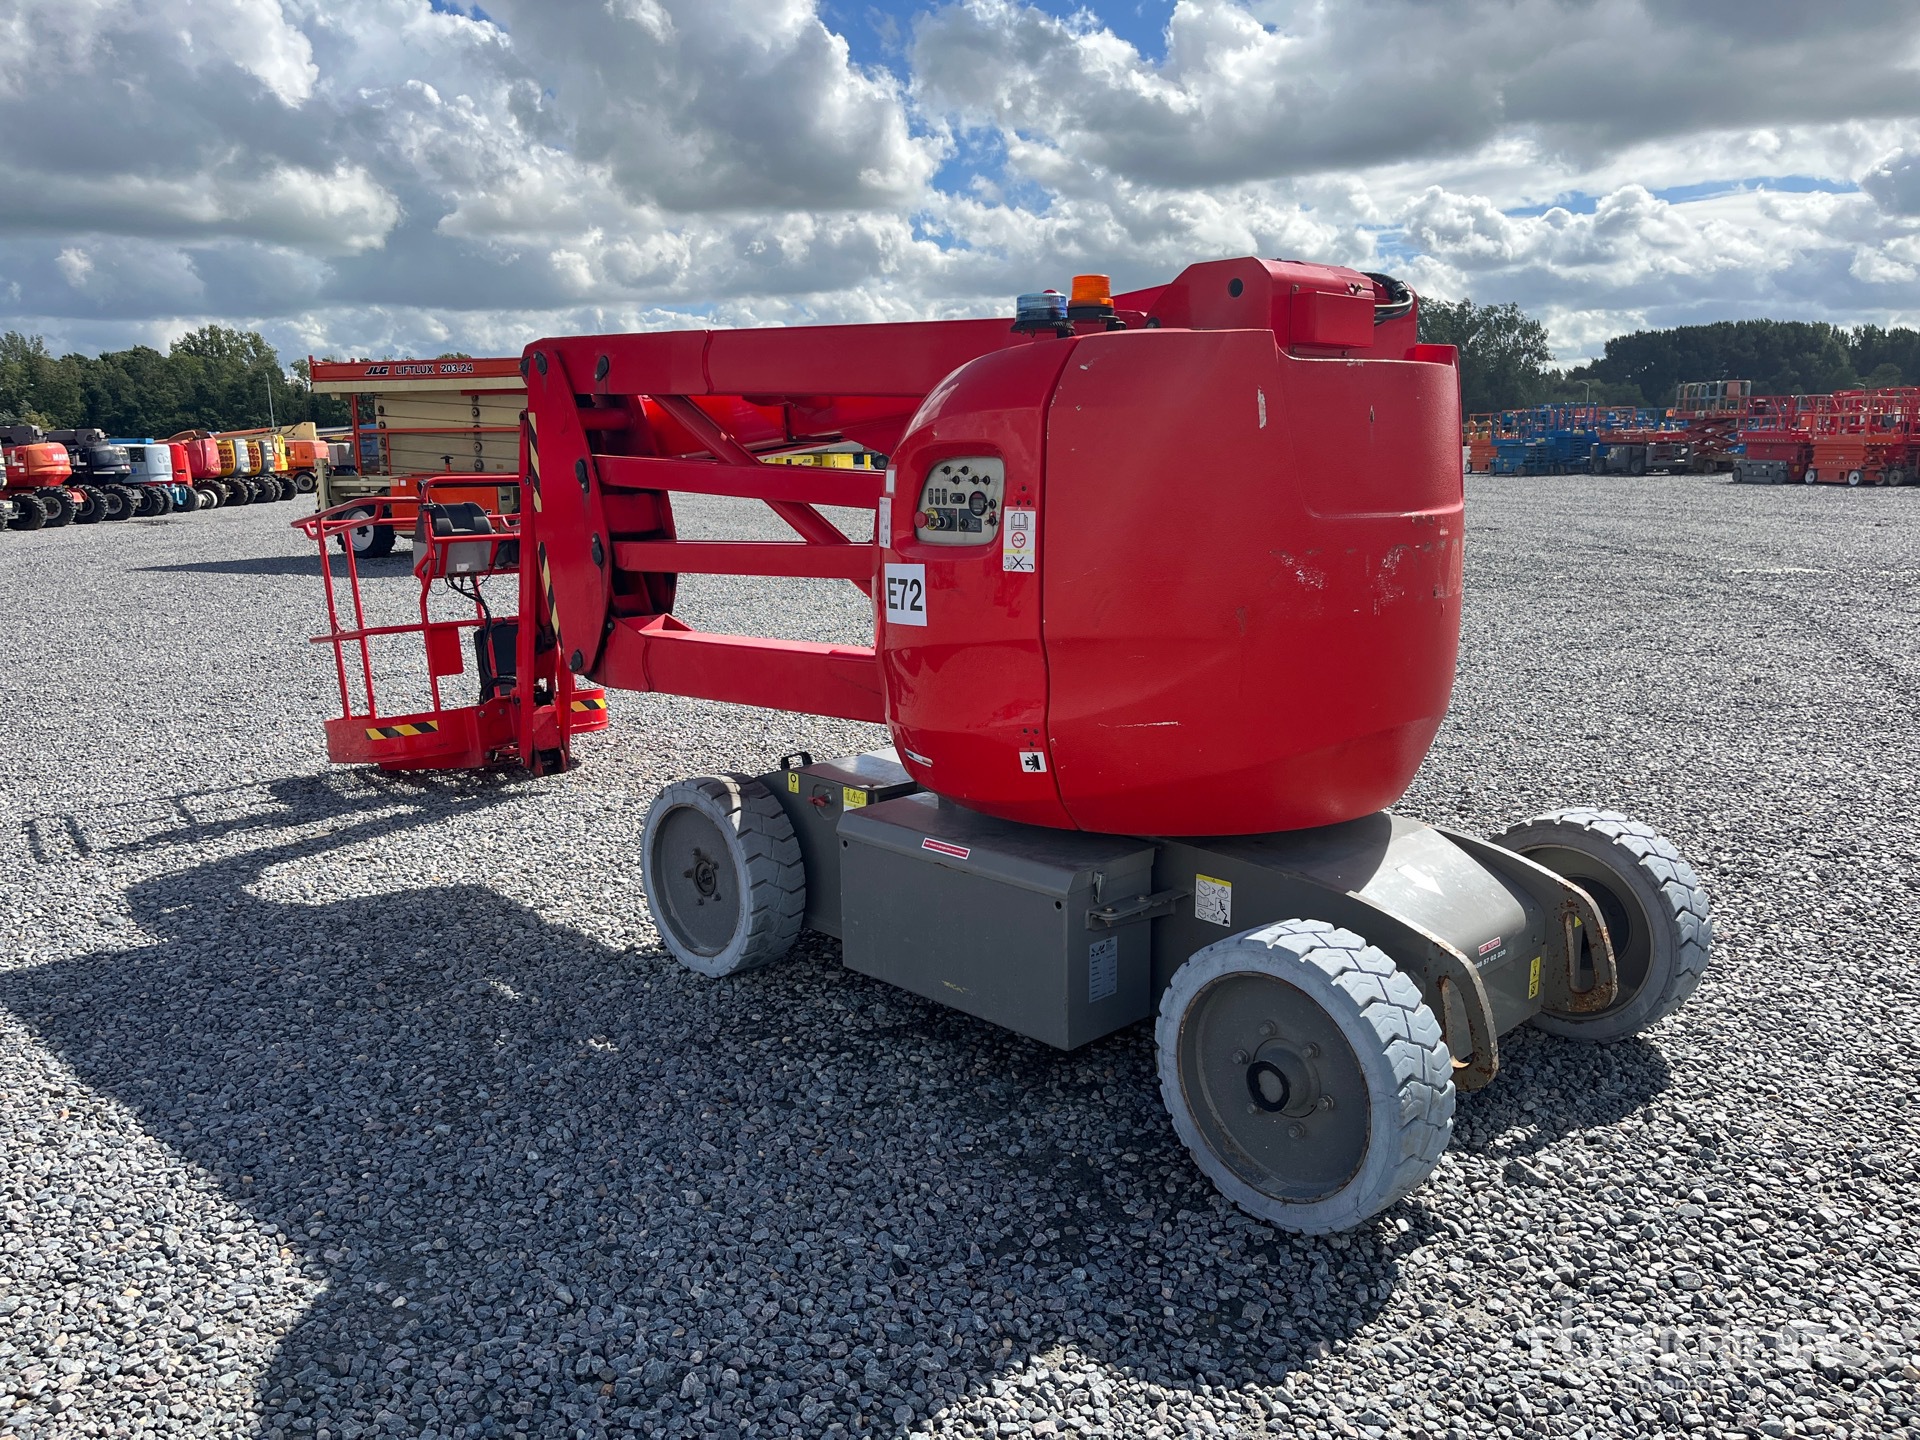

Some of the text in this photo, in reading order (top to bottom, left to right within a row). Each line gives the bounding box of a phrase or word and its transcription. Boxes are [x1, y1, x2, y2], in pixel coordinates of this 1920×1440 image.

[365, 363, 473, 375] JLG LIFTLUX 203-24
[888, 578, 923, 612] E72
